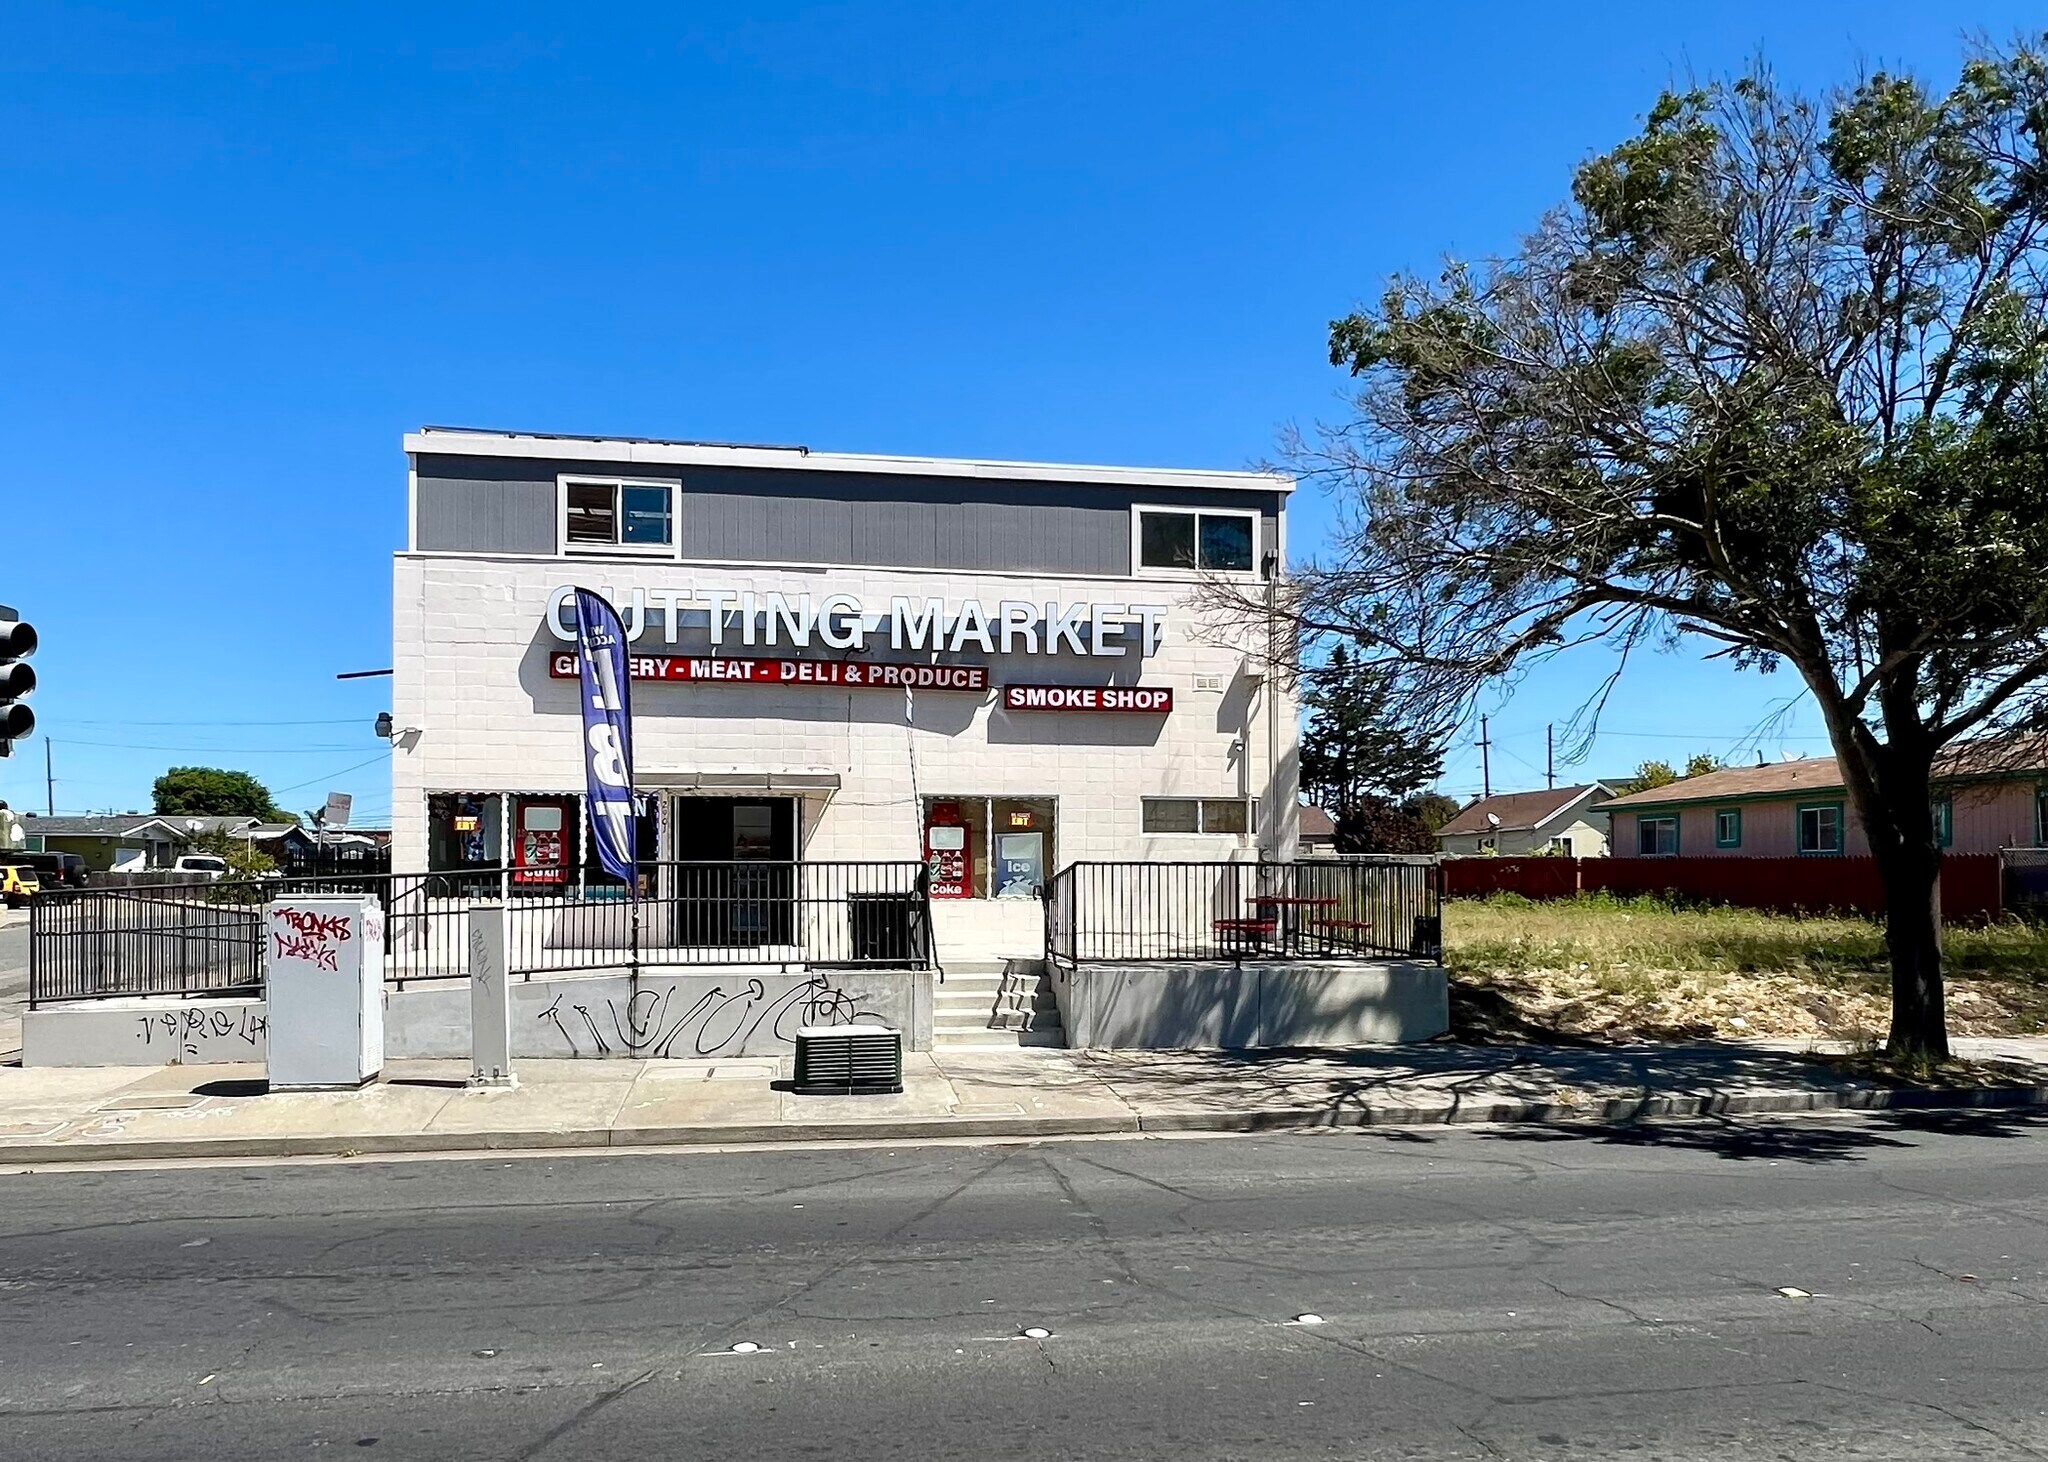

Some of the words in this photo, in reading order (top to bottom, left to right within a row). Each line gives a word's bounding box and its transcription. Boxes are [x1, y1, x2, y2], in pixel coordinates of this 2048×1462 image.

[547, 585, 865, 649] CUTTING
[890, 596, 1167, 658] MARKET
[690, 659, 755, 679] MEAT
[780, 661, 838, 681] DELI
[845, 664, 862, 683] &
[868, 666, 983, 687] PRODUCE
[1009, 688, 1096, 708] SMOKE
[1102, 689, 1168, 708] SHOP
[1007, 861, 1030, 873] Ice
[930, 883, 962, 895] Coke
